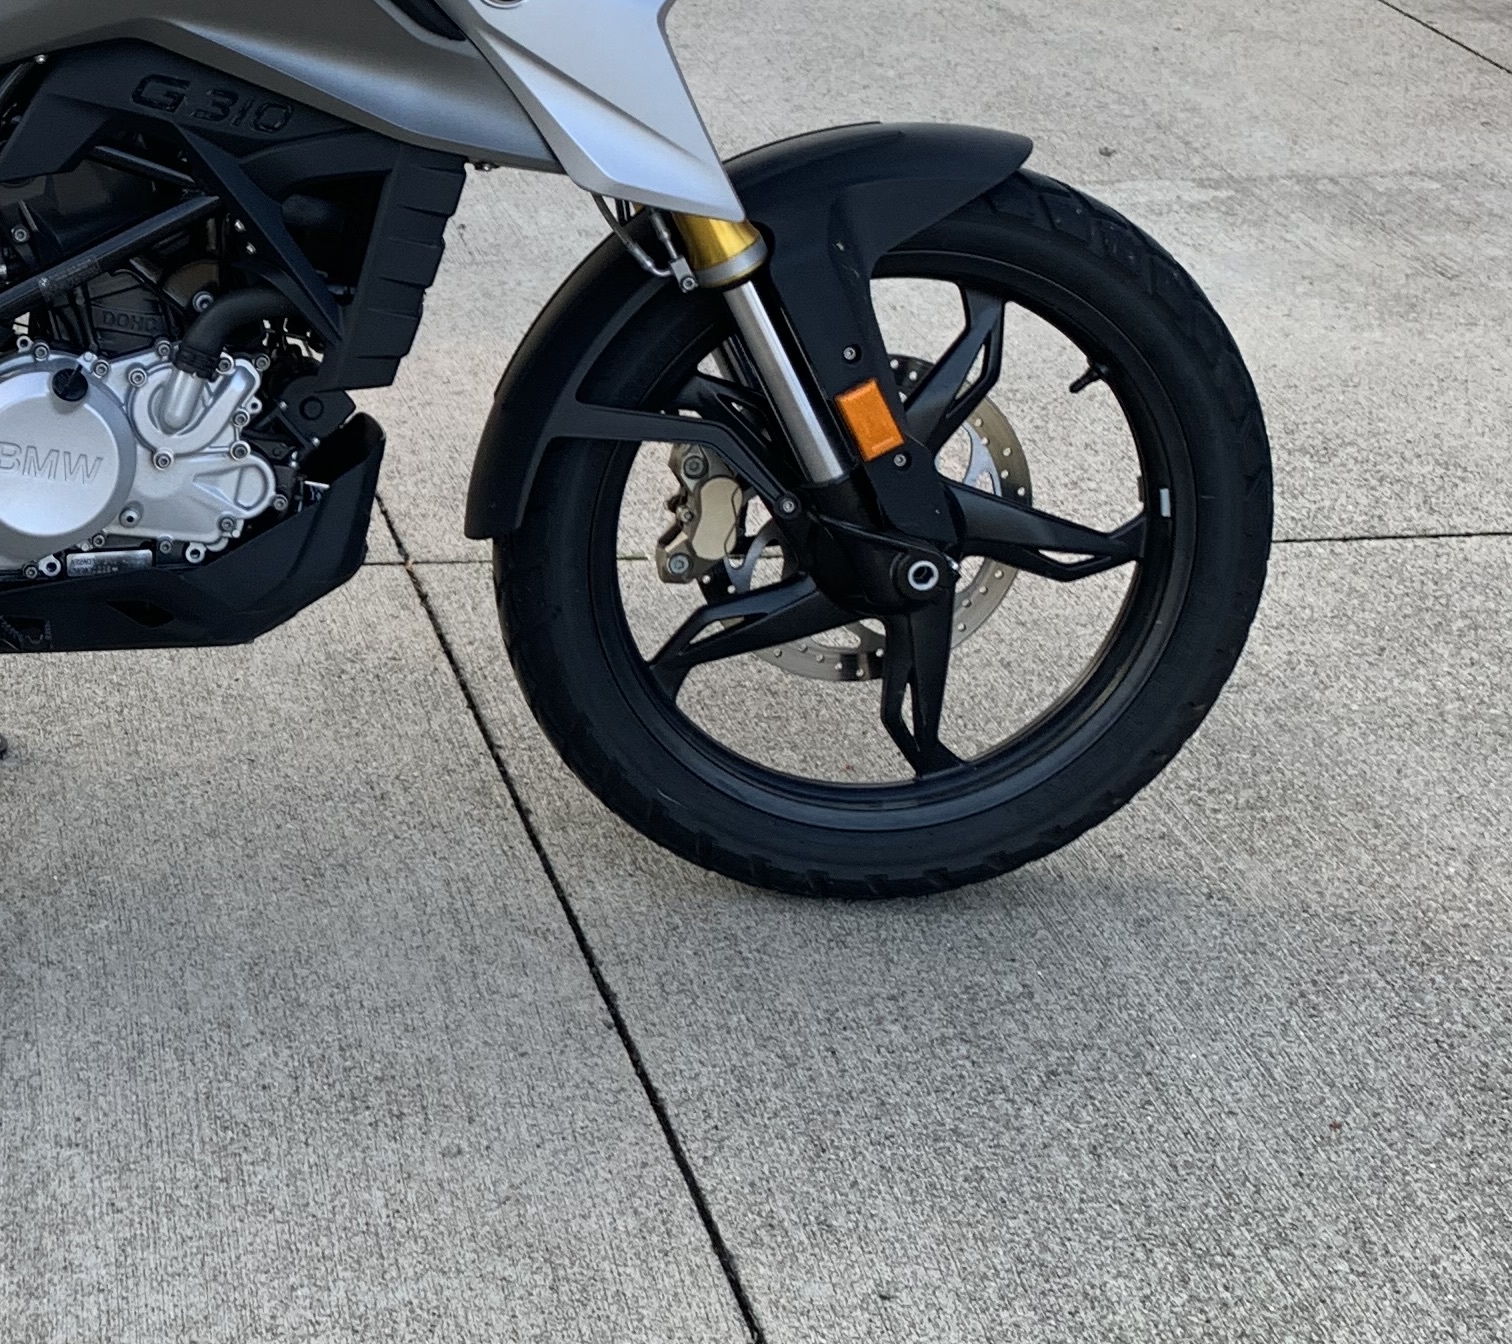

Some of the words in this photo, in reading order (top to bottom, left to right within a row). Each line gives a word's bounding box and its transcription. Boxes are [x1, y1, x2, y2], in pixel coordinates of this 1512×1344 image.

[131, 73, 191, 113] G
[190, 89, 294, 134] 310
[102, 310, 160, 333] DOHC
